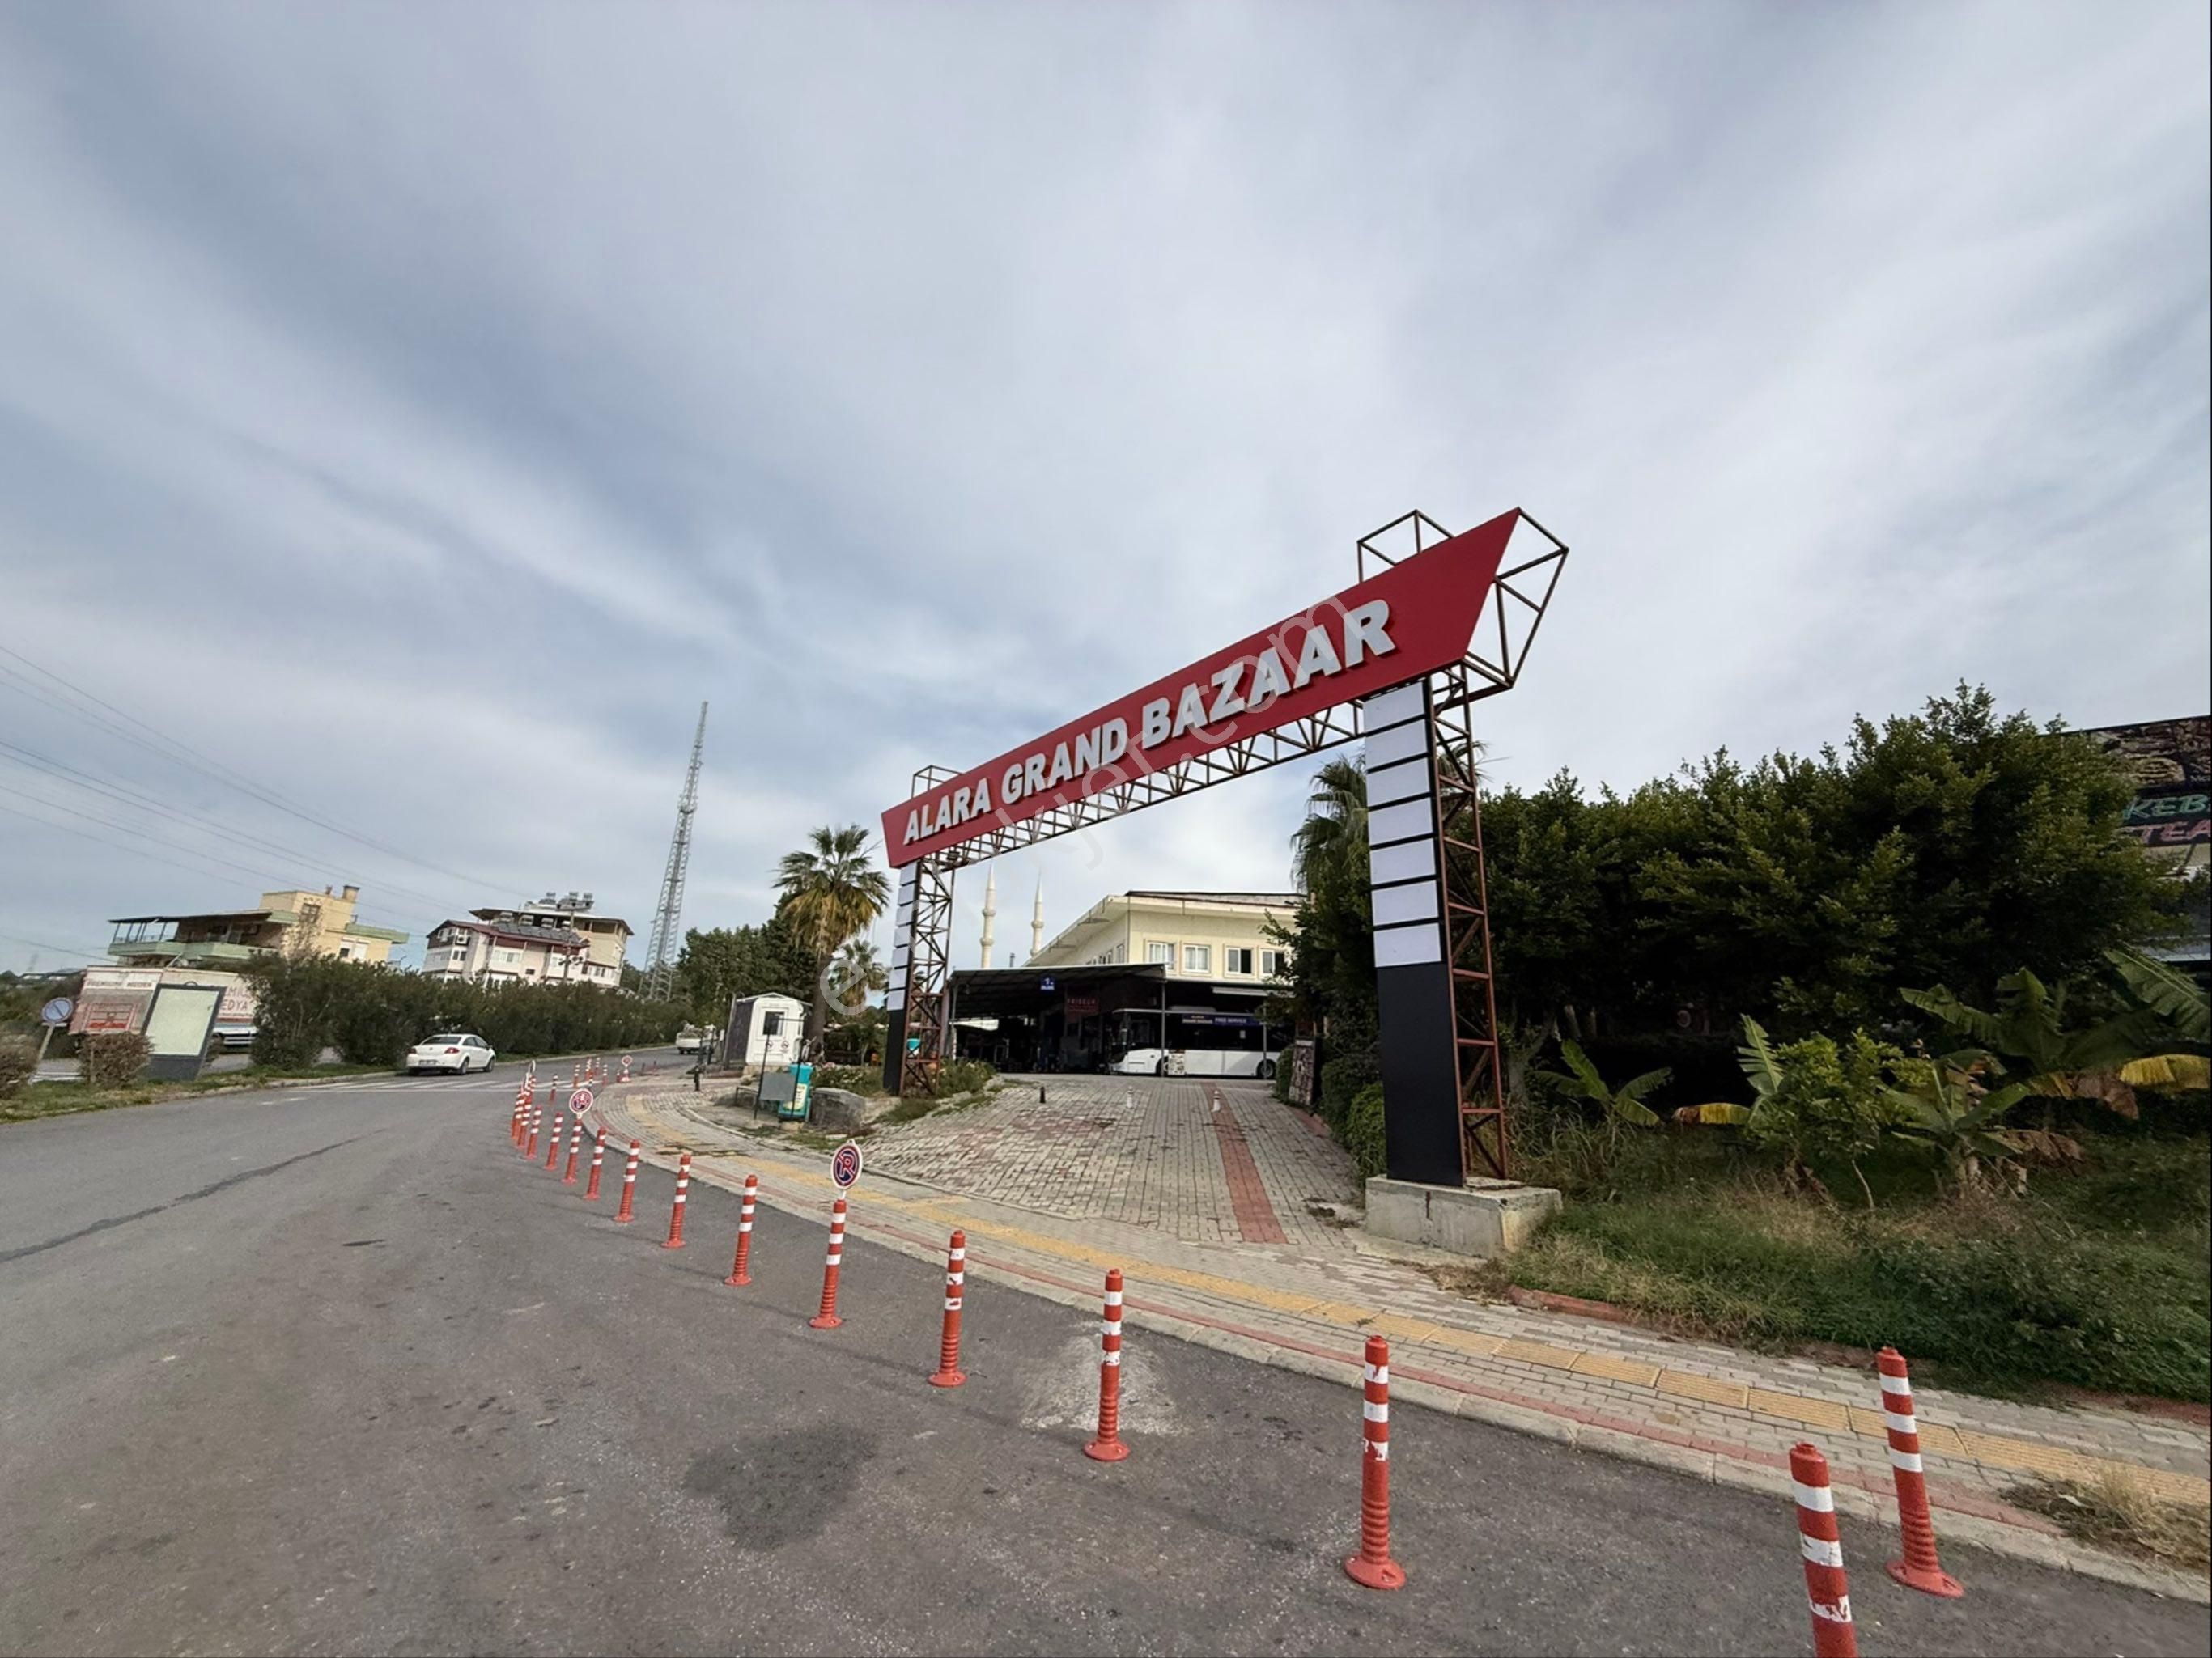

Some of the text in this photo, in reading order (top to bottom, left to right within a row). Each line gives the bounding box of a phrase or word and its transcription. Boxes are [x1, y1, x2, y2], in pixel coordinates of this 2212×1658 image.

[903, 600, 1396, 846] ALARA GRAND BAZAAR
[2123, 794, 2210, 820] KEB
